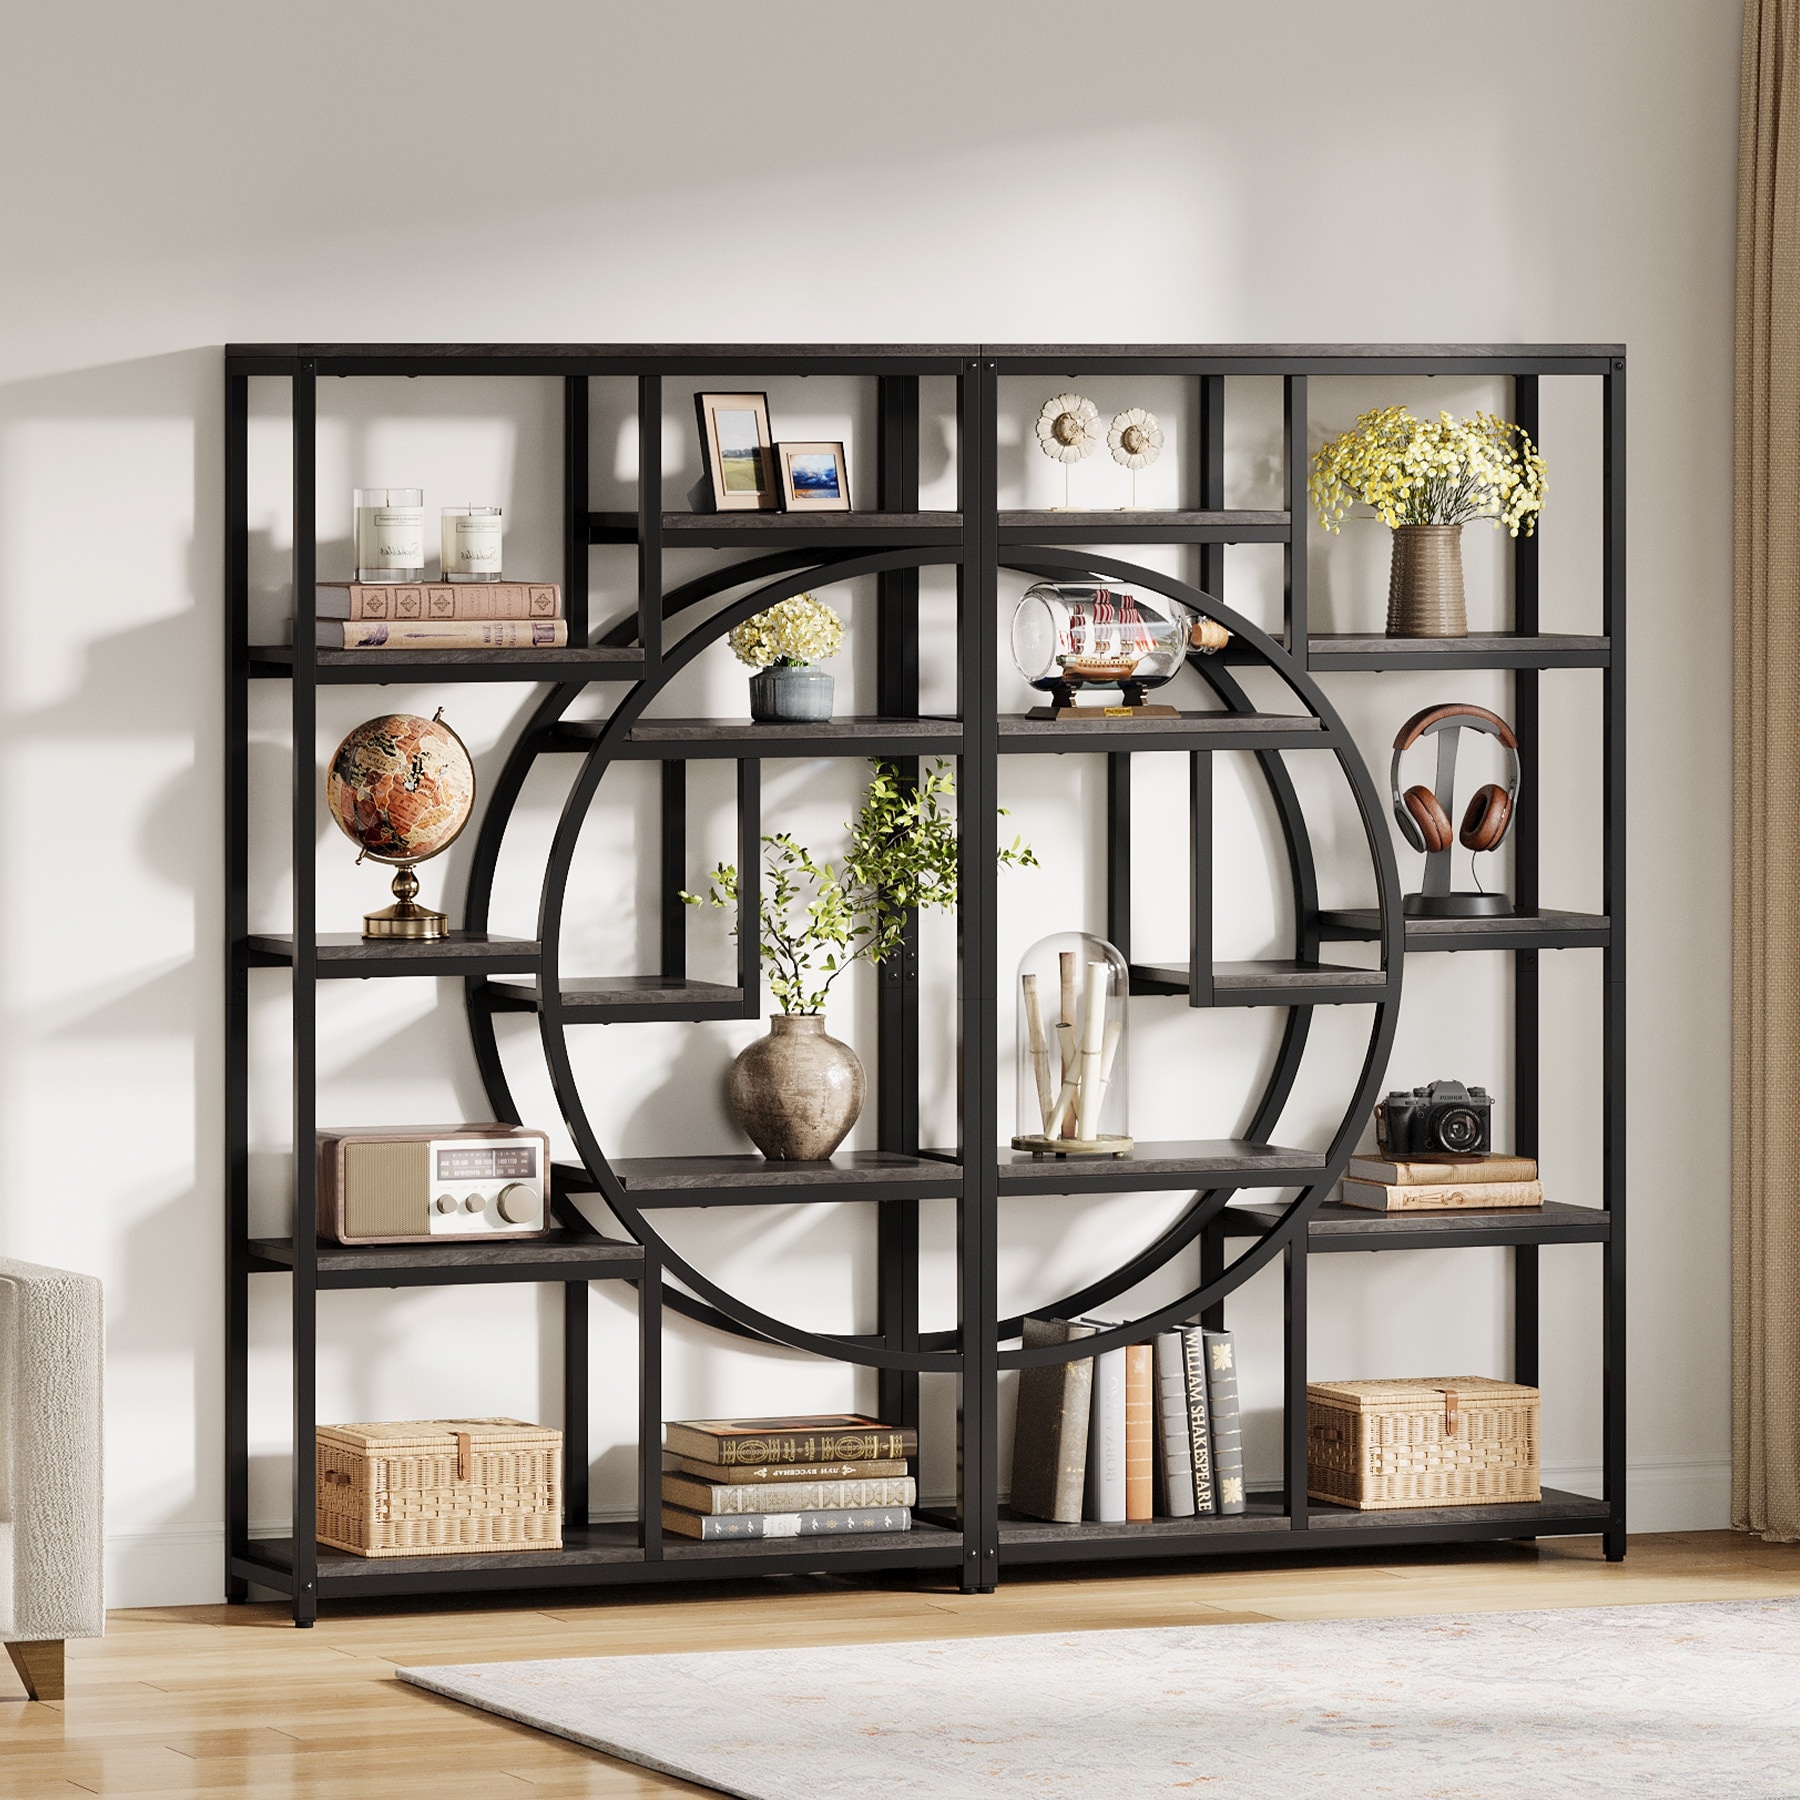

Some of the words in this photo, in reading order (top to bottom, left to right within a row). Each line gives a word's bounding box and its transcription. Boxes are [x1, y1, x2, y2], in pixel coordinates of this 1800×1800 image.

[1185, 1331, 1201, 1402] WILLIAM
[821, 1466, 839, 1475] ЛУИ
[1190, 1405, 1211, 1512] SHAKESPEARE
